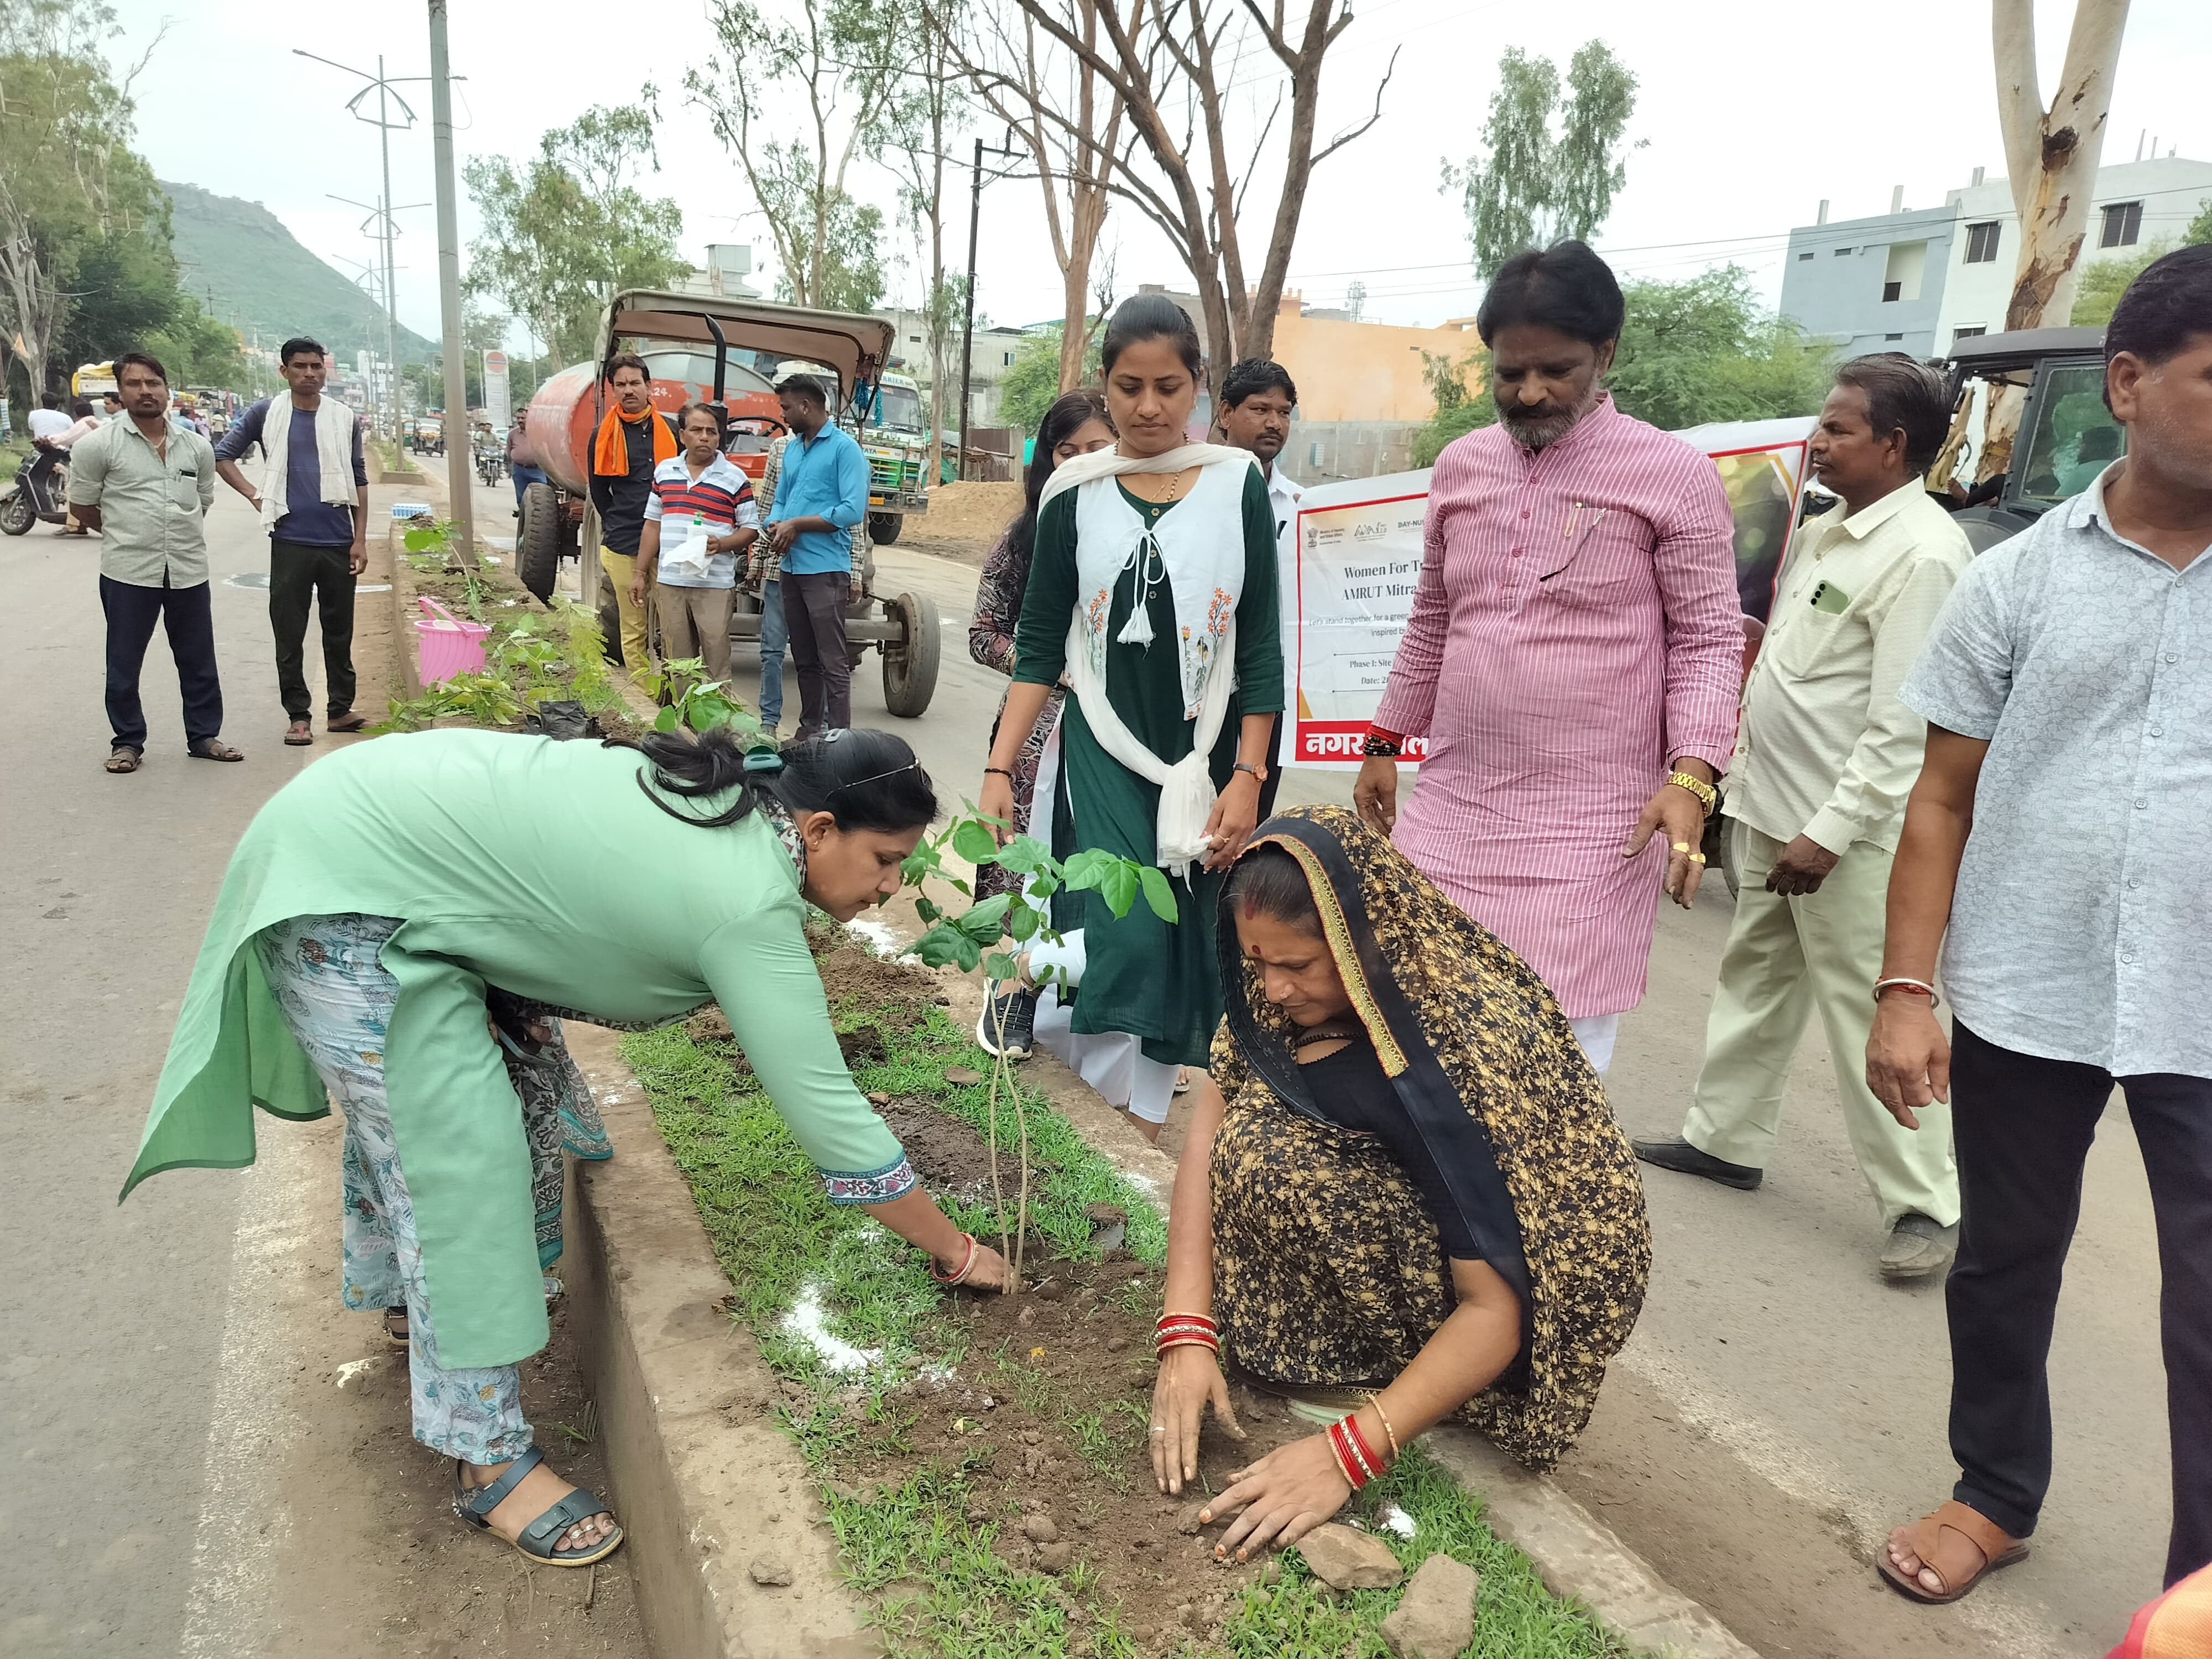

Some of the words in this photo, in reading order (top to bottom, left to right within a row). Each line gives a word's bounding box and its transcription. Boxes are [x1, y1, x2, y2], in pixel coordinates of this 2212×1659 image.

[883, 376, 904, 385] RRIER
[1344, 566, 1386, 579] Women
[1389, 562, 1408, 575] For
[1342, 586, 1383, 601] AMRUT
[1386, 584, 1417, 597] Mitra
[1344, 615, 1371, 624] together
[1371, 627, 1397, 637] inspired
[1378, 659, 1392, 667] Site
[1306, 733, 1365, 755] नगर
